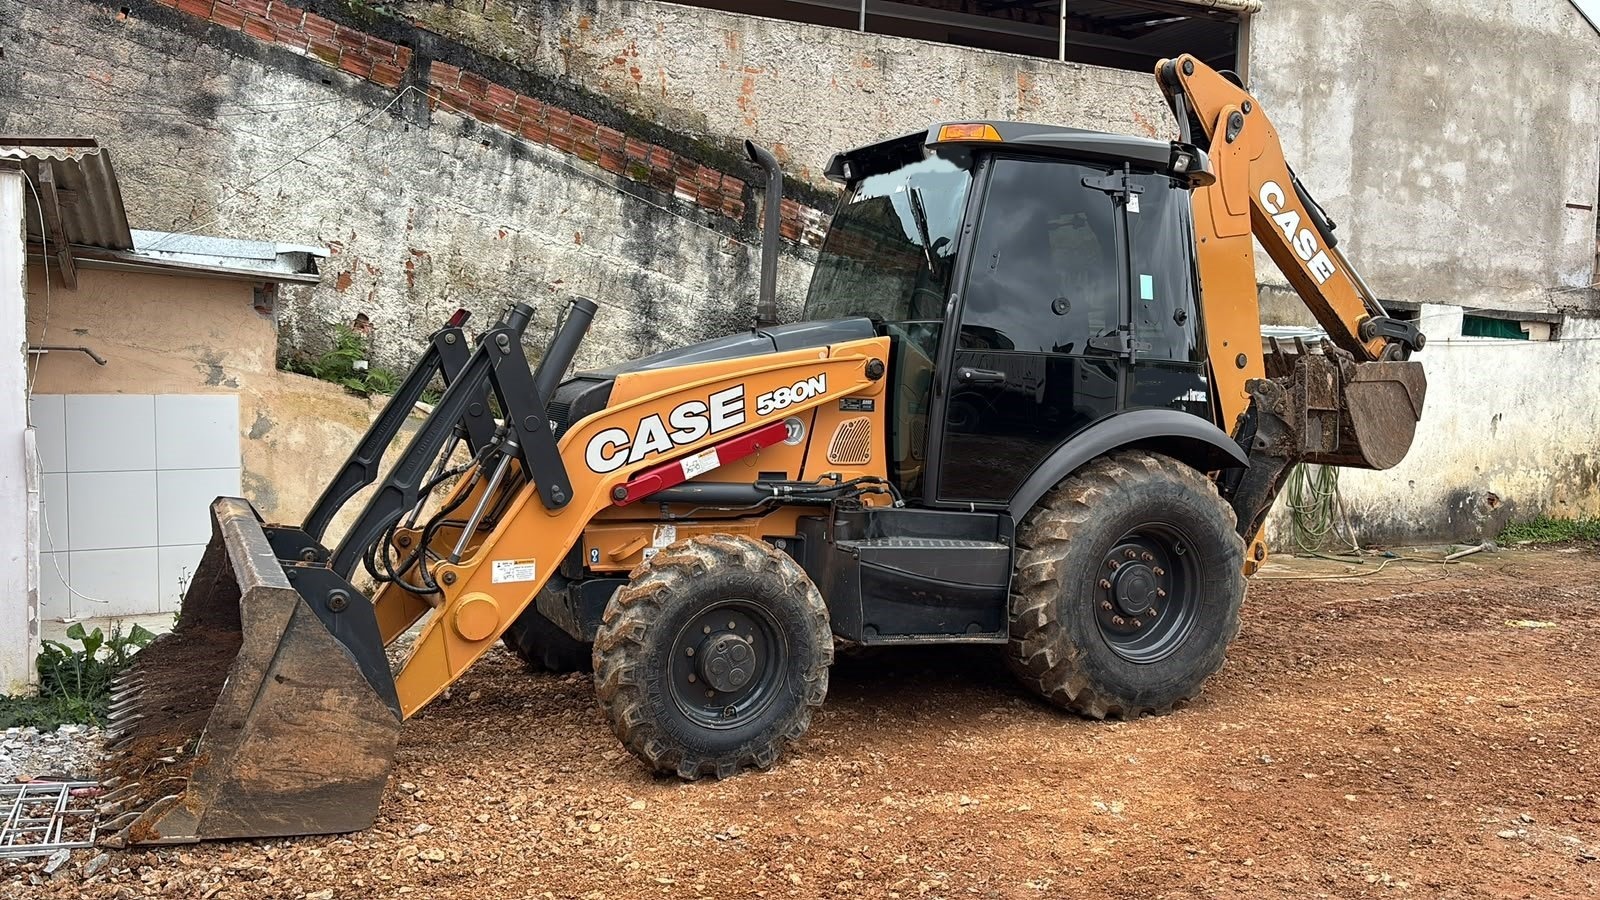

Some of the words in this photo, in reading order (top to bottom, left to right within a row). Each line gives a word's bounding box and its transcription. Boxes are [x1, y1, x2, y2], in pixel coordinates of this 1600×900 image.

[1259, 180, 1336, 285] CASE
[585, 383, 746, 473] CASE
[755, 372, 827, 416] 580N
